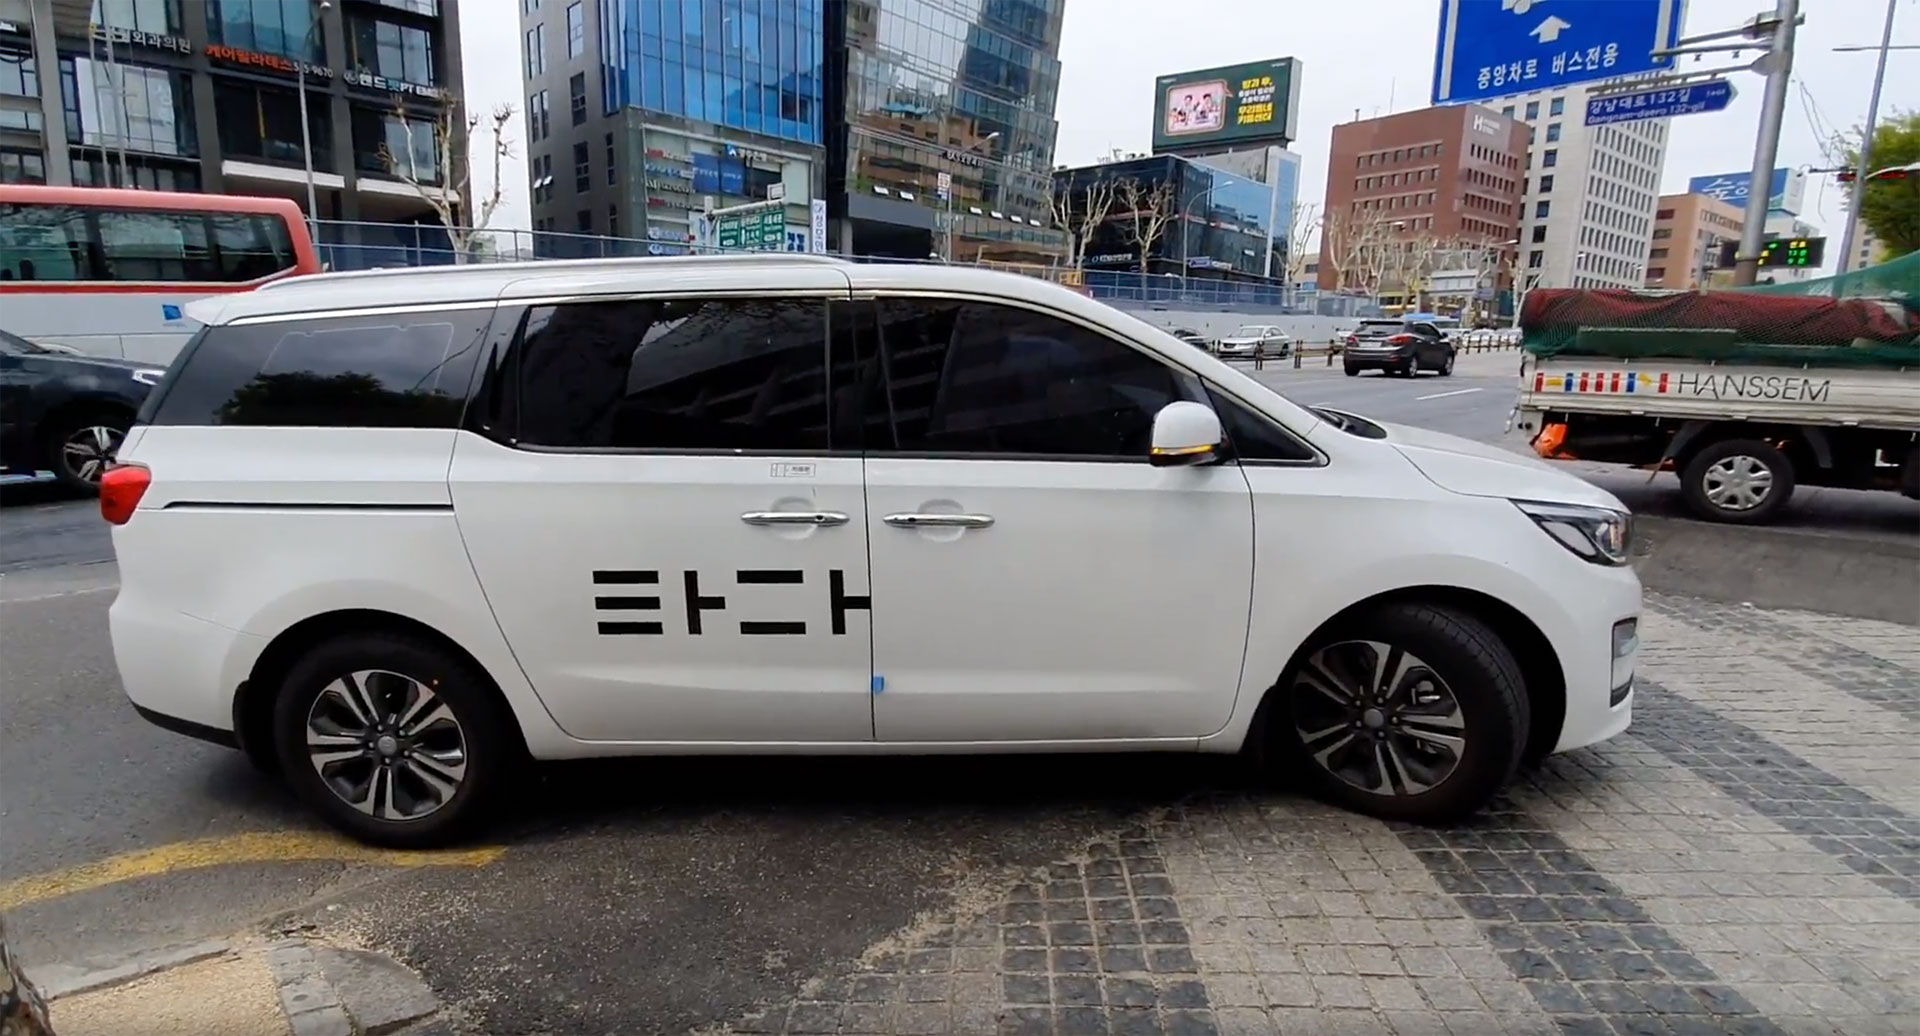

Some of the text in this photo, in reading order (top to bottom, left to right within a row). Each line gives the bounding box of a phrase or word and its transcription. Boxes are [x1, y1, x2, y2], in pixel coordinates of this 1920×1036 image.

[1477, 42, 1619, 90] 중앙차로 버스전용
[1590, 88, 1691, 114] 강남대로132길
[1587, 108, 1668, 125] Gangnam-daero
[1677, 373, 1831, 403] HANSSEM
[592, 569, 872, 636] 타다
